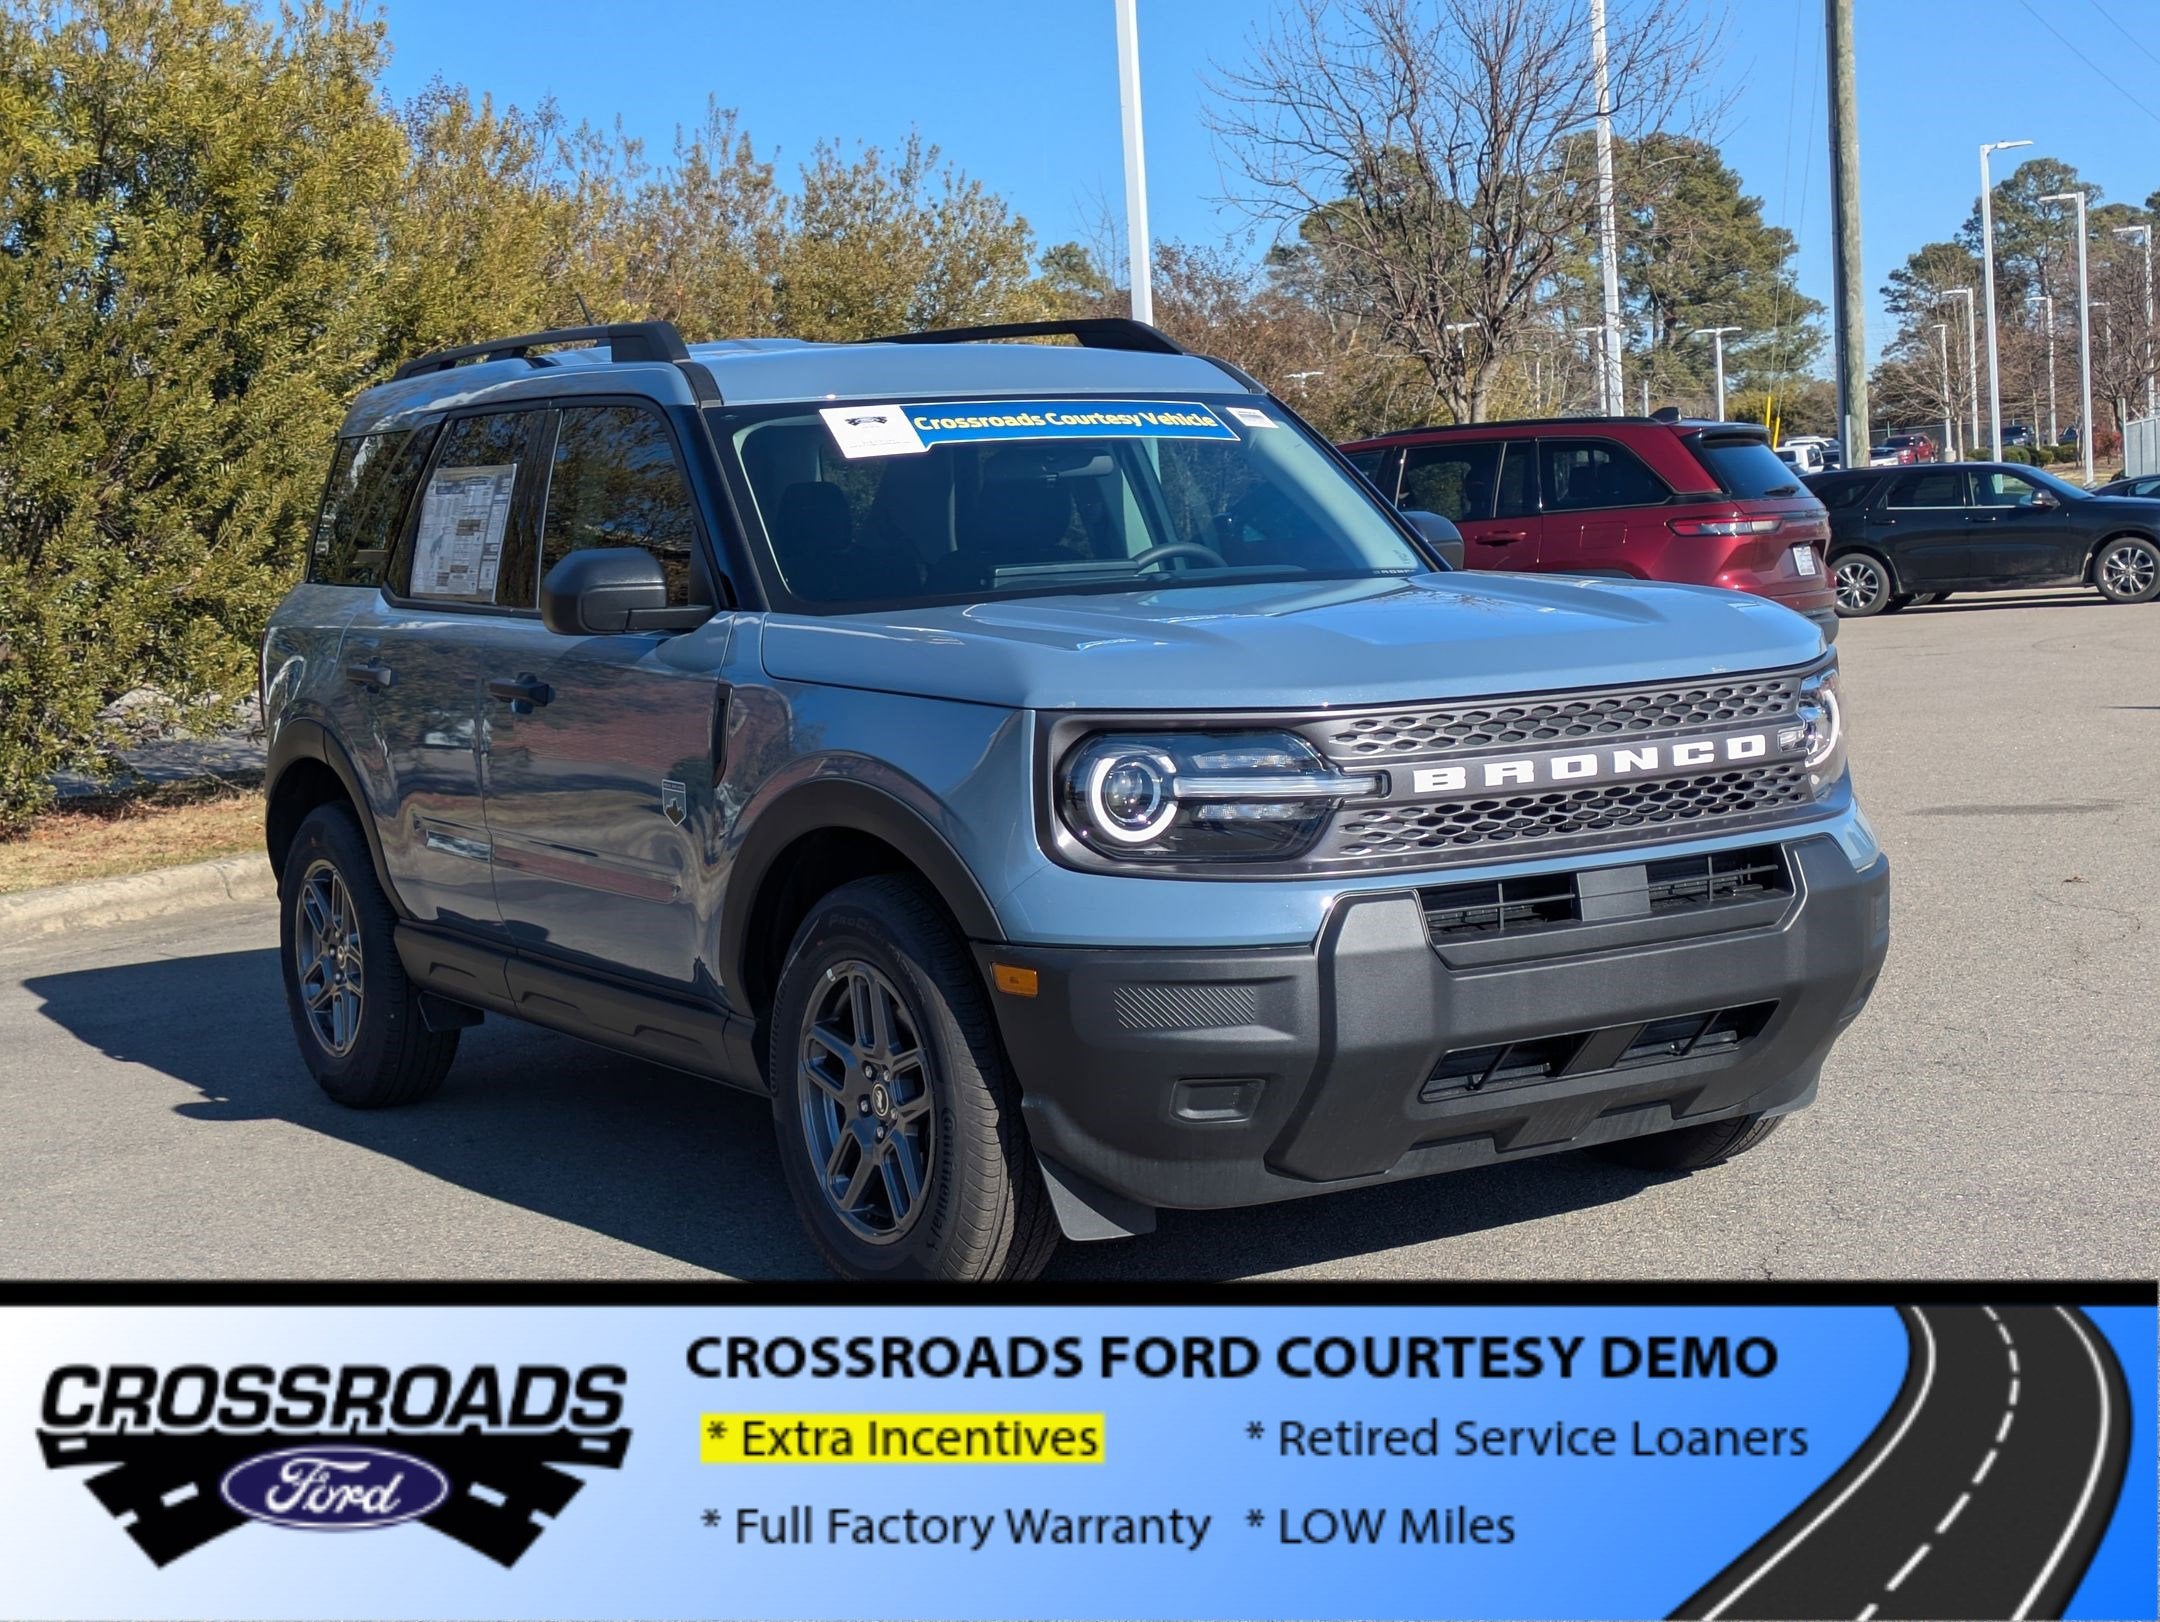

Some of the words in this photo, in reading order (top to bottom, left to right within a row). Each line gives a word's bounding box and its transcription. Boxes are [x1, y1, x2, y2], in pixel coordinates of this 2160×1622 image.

[912, 413, 1047, 431] Crossroads
[1044, 412, 1142, 428] Courtesy
[1139, 412, 1219, 428] Vehicle
[1413, 734, 1766, 793] BRONCO
